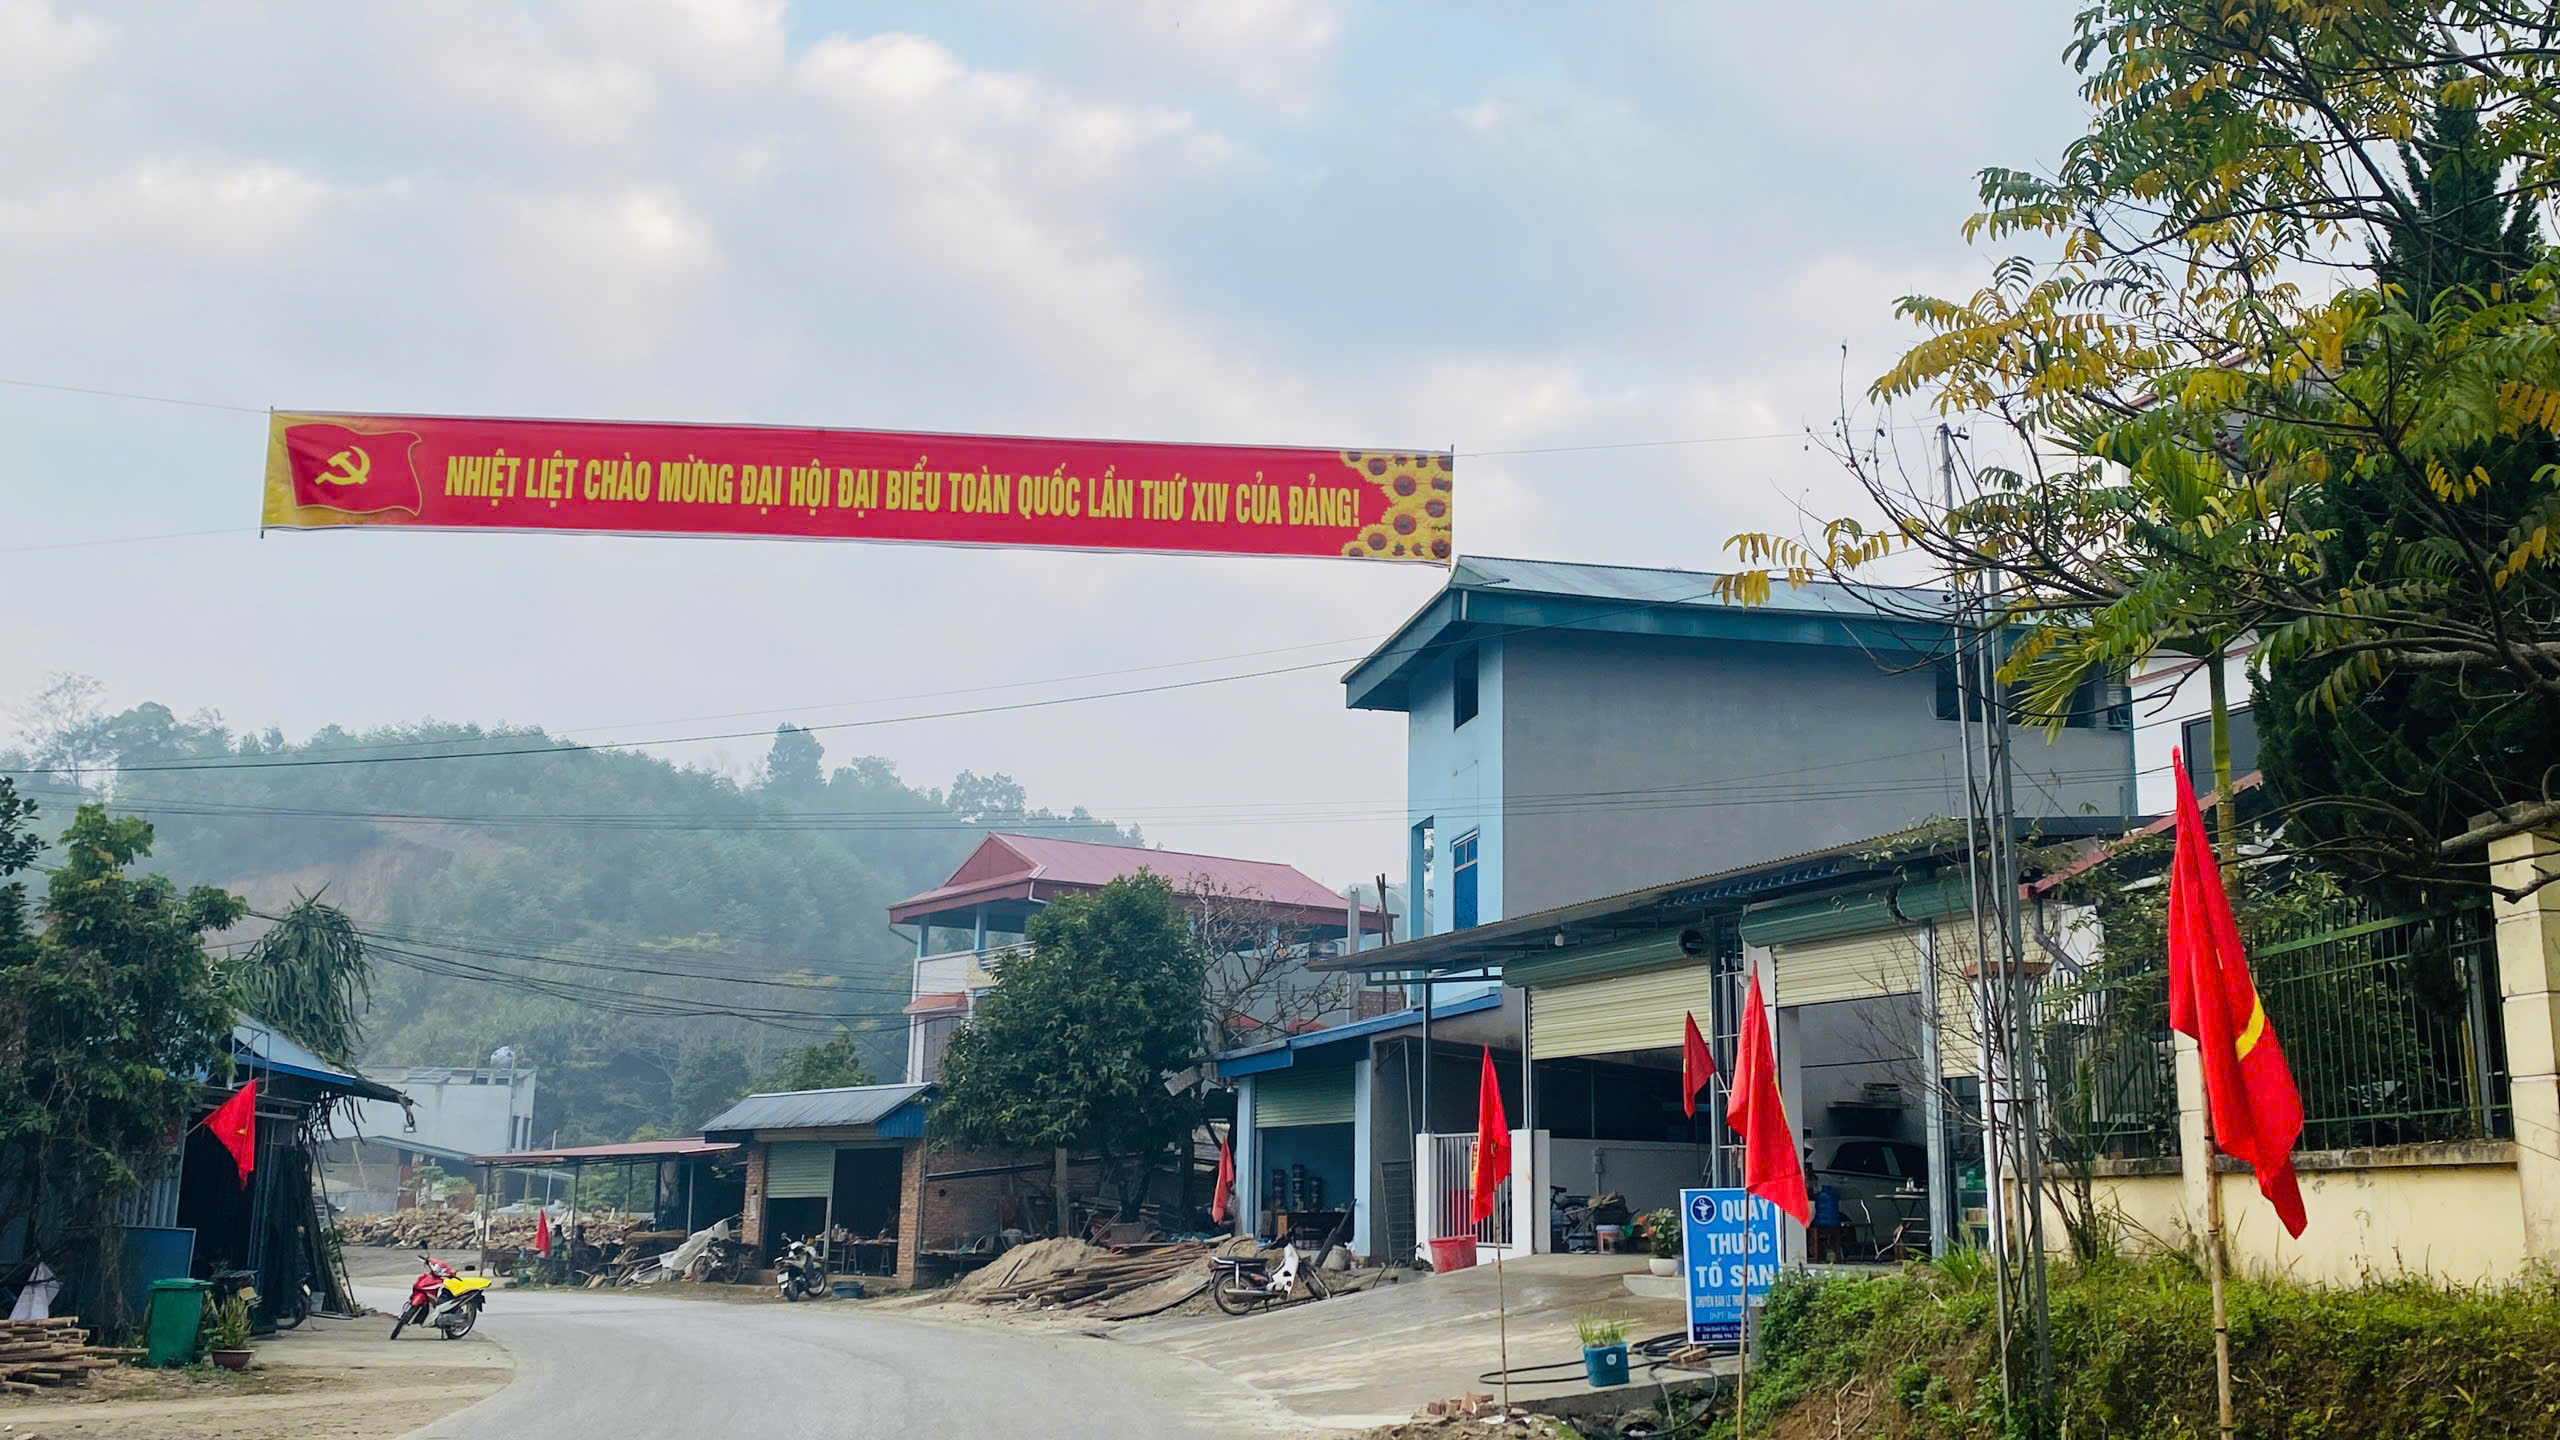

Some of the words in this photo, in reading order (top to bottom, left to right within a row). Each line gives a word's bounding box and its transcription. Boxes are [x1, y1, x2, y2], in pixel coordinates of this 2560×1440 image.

[444, 448, 521, 507] NHIỆT
[525, 449, 579, 508] LIỆT
[583, 452, 652, 503] CHÀO
[658, 454, 734, 505] MỪNG
[740, 464, 783, 515] ĐẠI
[789, 458, 831, 516] HỘI
[837, 468, 879, 518] ĐẠI
[885, 455, 942, 512] BIỂU
[948, 465, 1011, 514] TOÀN
[1017, 462, 1081, 519] QUỐC
[1087, 464, 1134, 519] LẦN
[1140, 472, 1188, 521] THỨ
[1190, 481, 1230, 523] XIV
[1235, 471, 1282, 525] CỦA
[1287, 472, 1360, 528] ĐẢNG!
[1707, 1225, 1771, 1256] THUỐC
[1695, 1258, 1723, 1288] TỐ
